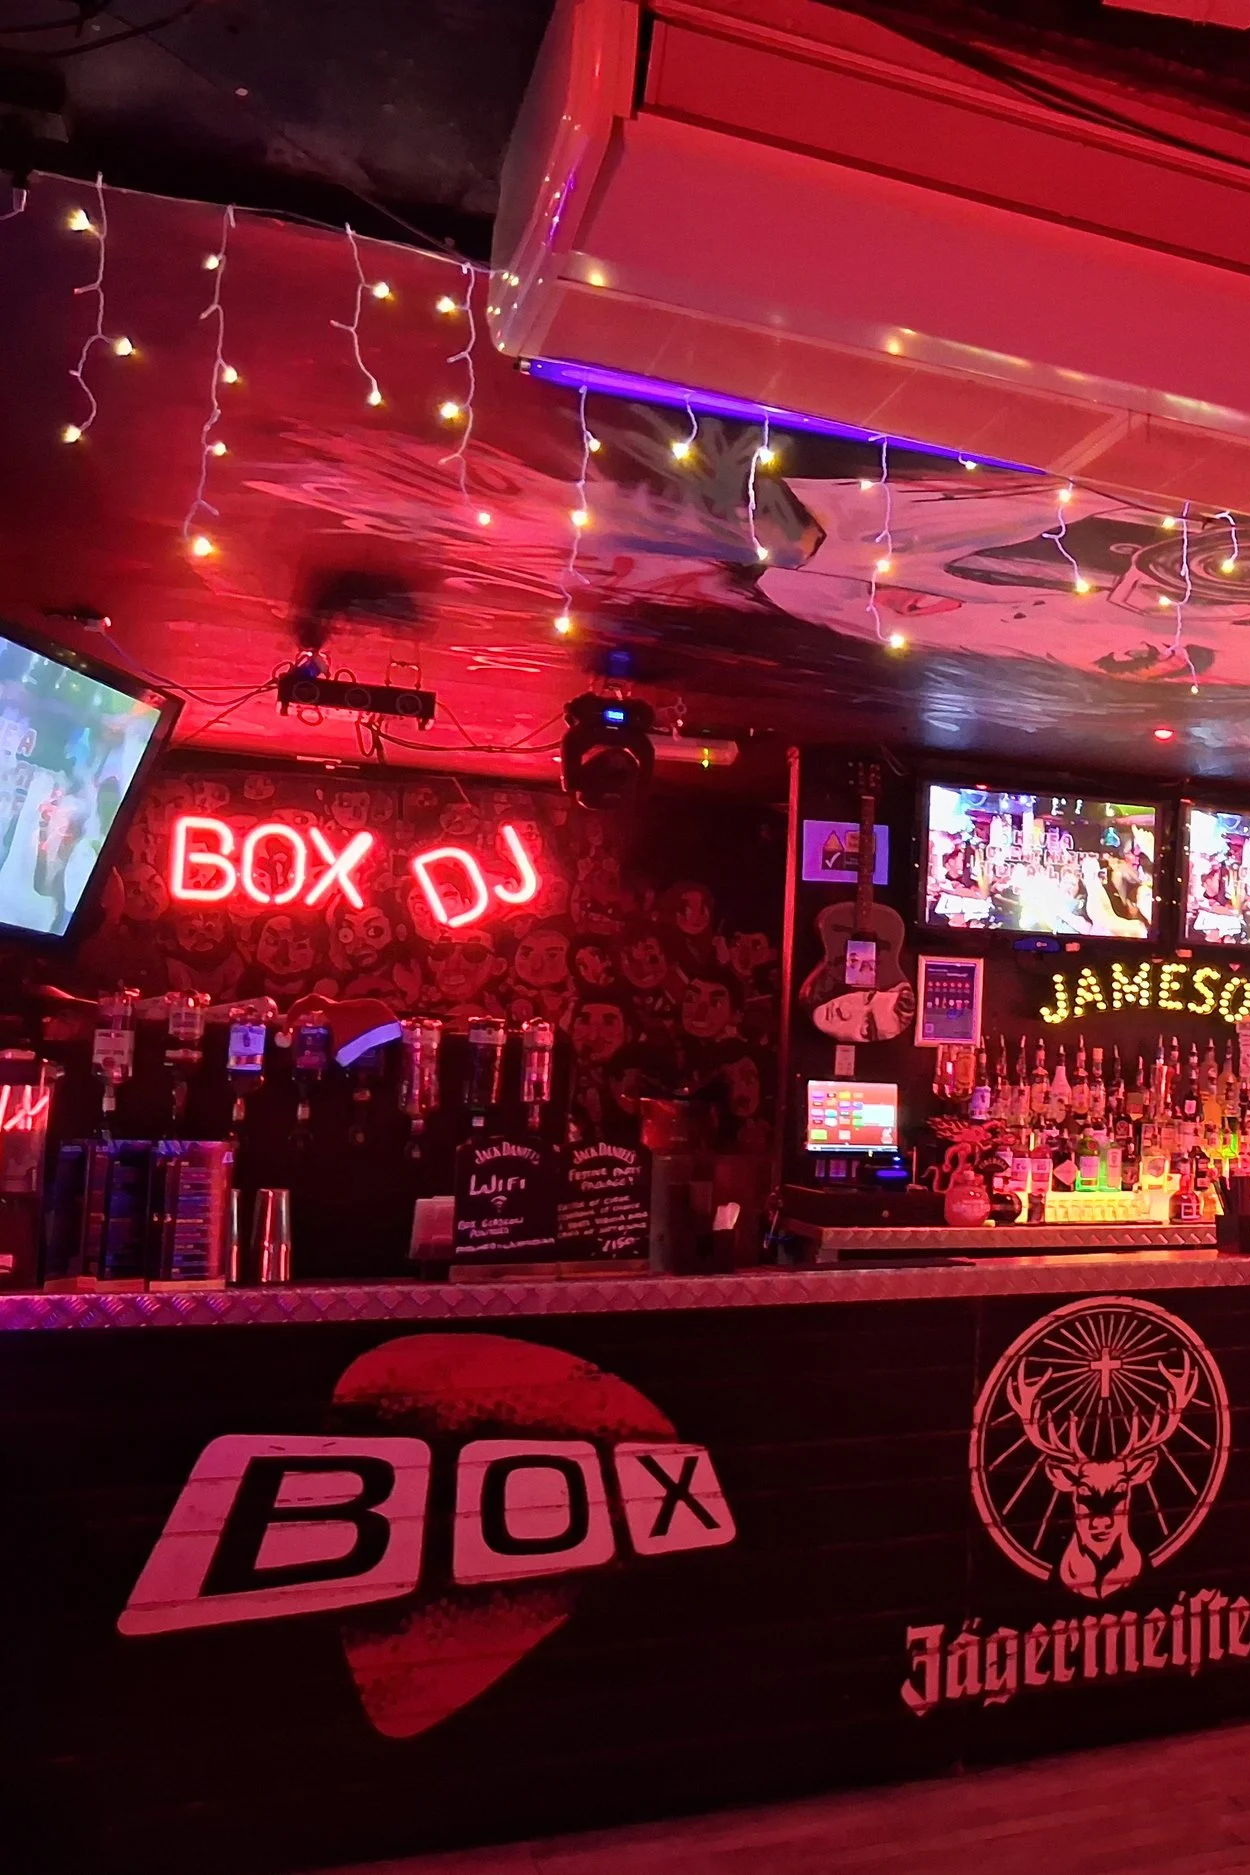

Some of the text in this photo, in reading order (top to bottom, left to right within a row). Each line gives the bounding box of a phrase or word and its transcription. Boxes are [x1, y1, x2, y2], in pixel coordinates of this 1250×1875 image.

[172, 817, 539, 928] BOX DJ
[573, 1146, 598, 1165] JACK
[190, 1450, 726, 1602] BOX
